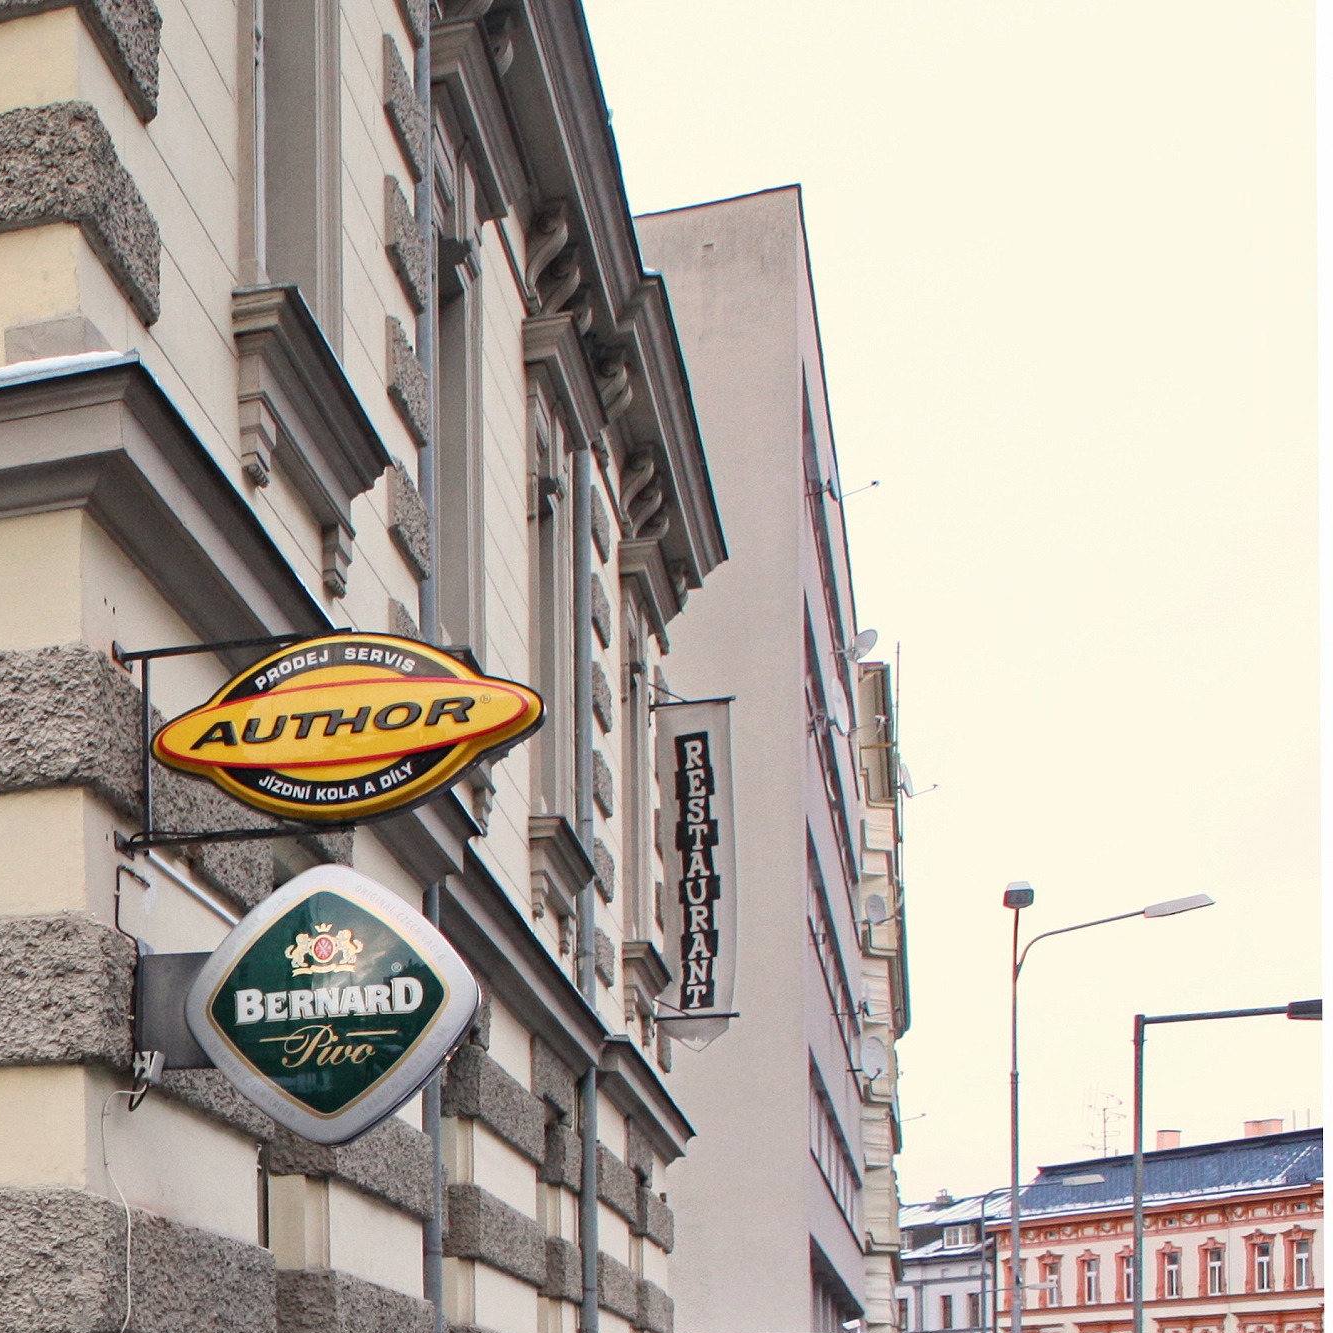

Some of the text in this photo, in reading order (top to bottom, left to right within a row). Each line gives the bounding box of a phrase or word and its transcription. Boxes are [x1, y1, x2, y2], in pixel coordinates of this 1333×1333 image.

[254, 648, 415, 691] PRODEJ SERVIS
[190, 696, 475, 751] AUTHOR
[259, 761, 415, 800] JÍZDNÍ KOLA A DÍLY
[684, 740, 710, 1008] RESTAURANT
[234, 977, 423, 1026] BERNARD
[282, 1023, 376, 1068] Pivo
